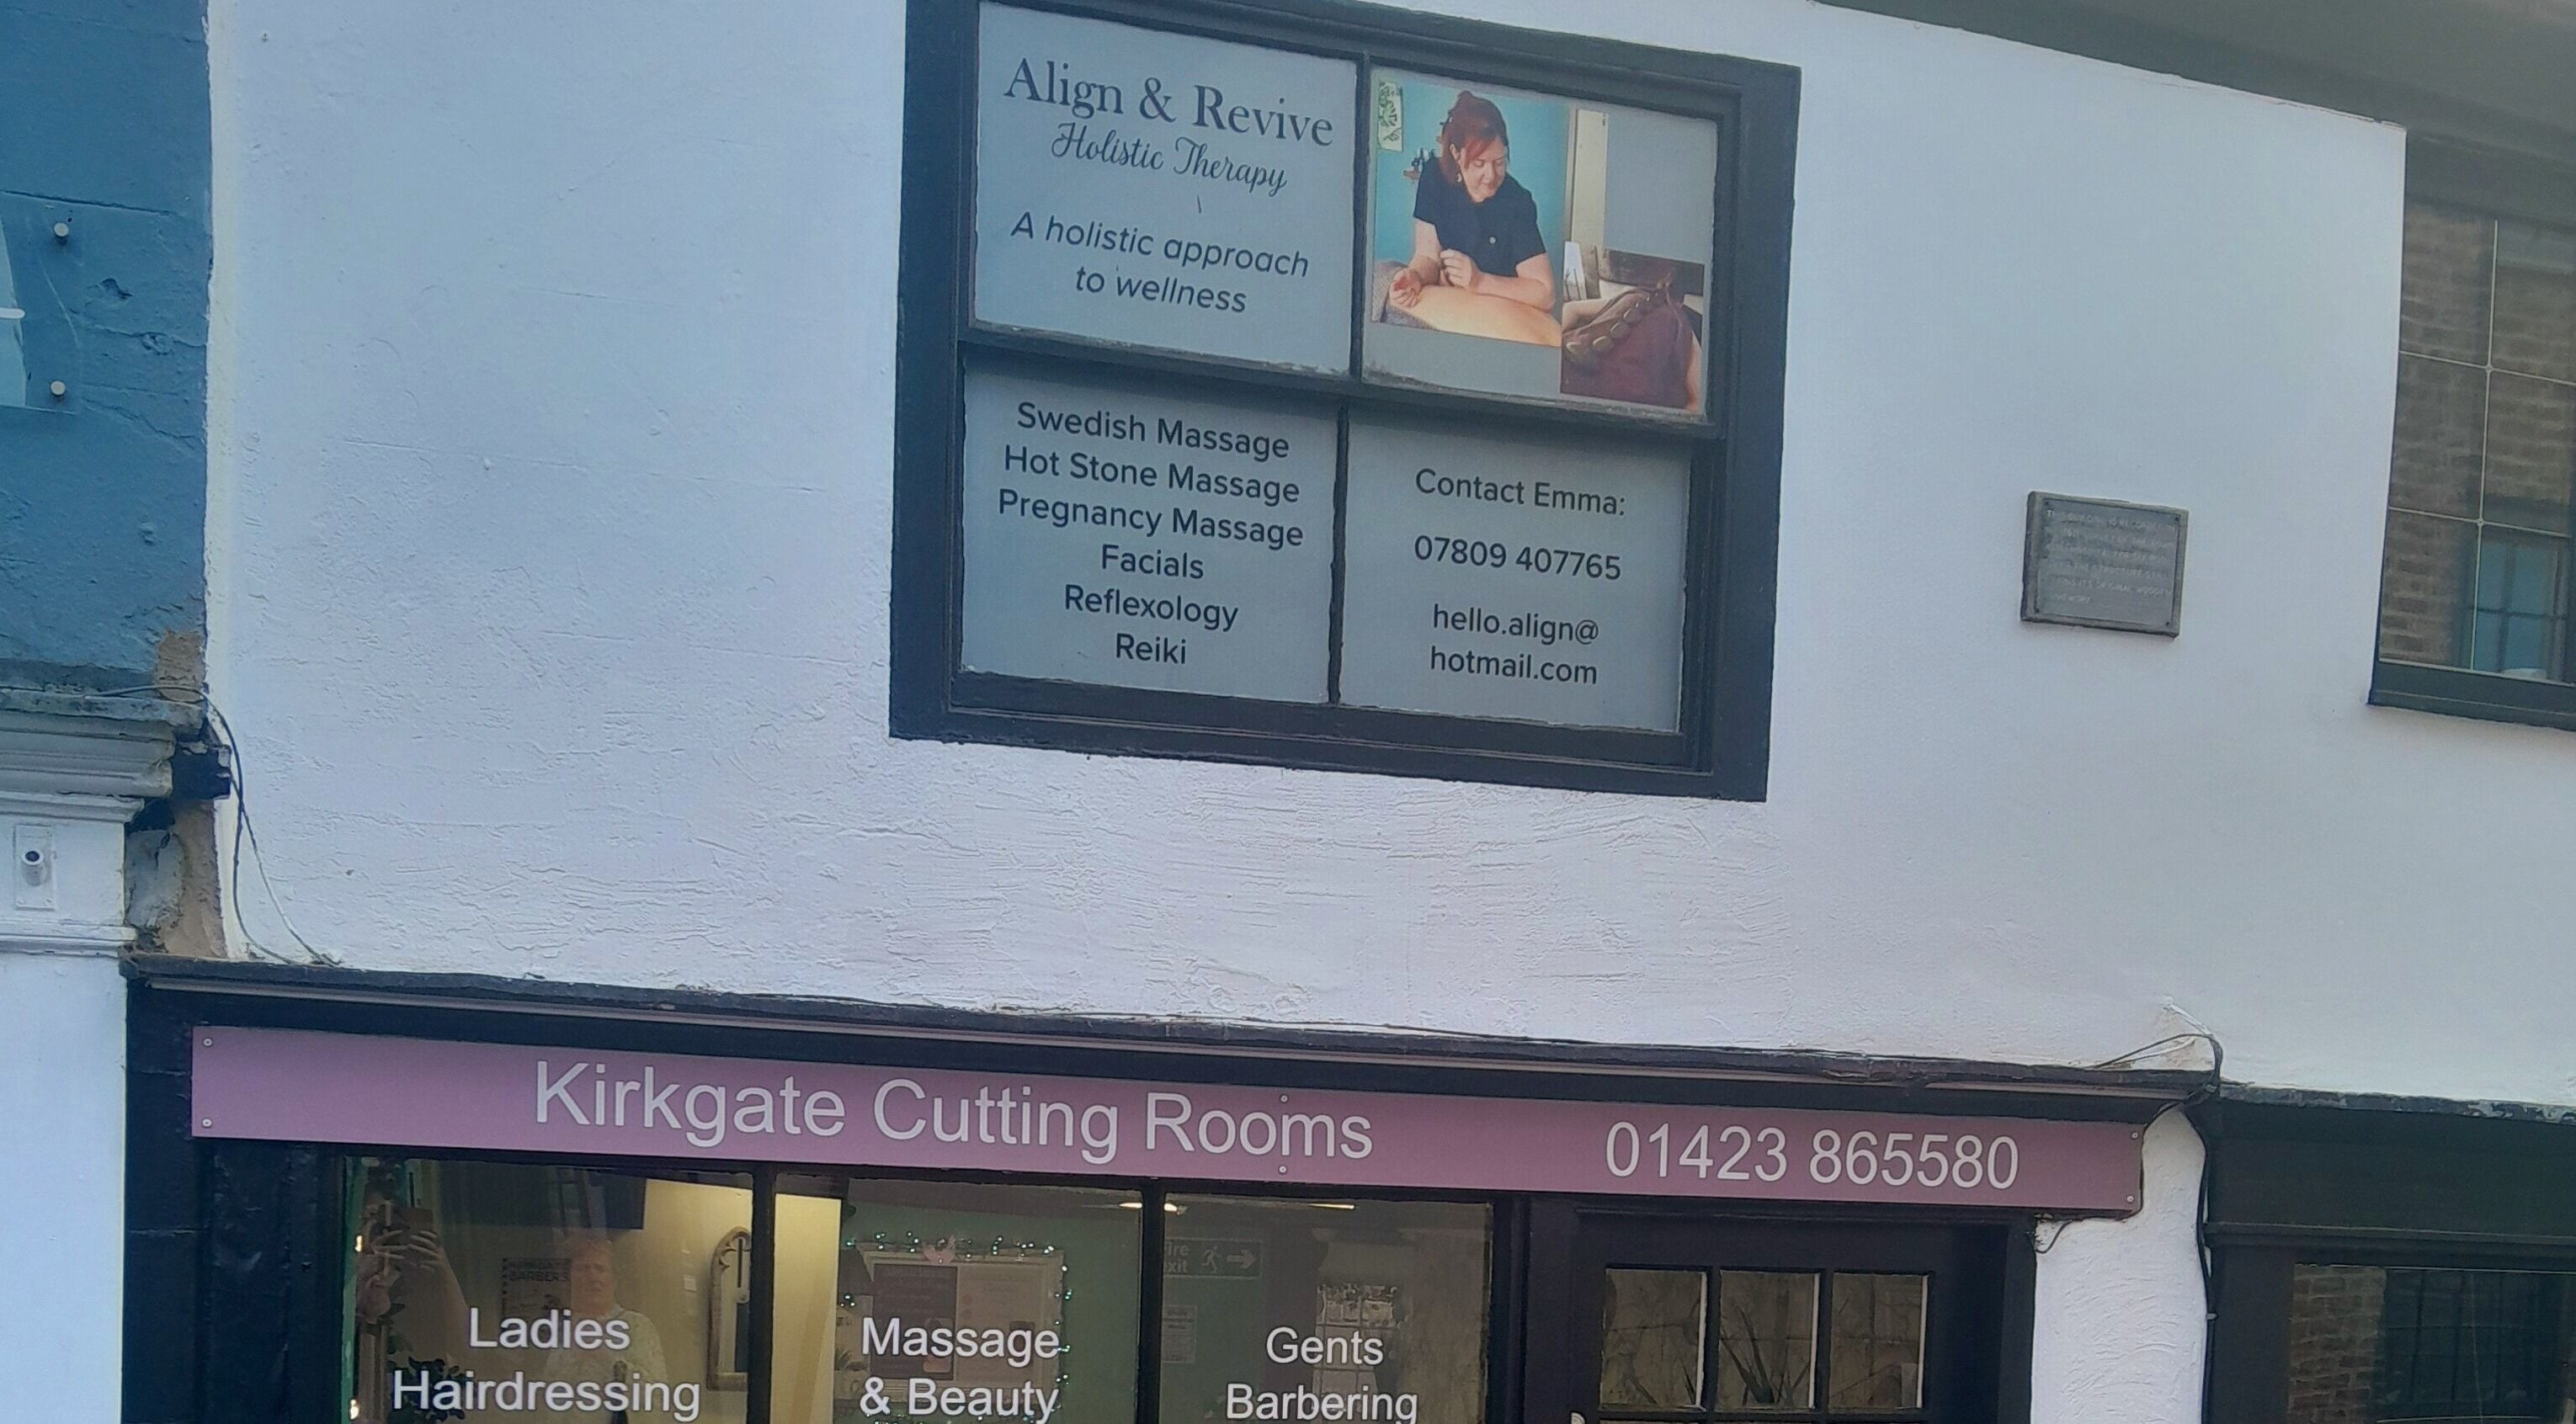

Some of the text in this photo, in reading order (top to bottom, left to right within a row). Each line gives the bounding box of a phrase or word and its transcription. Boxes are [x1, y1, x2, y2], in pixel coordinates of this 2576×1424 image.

[1003, 57, 1333, 146] Align & Revive
[1051, 122, 1288, 197] Holistic Therapy
[1010, 211, 1309, 278] A holistic approach
[1076, 266, 1248, 313] to wellness
[1017, 401, 1291, 463] Swedish Massage
[1004, 444, 1300, 507] Hot Stone Massage
[1415, 468, 1626, 516] Contact Emma:
[998, 488, 1304, 550] Pregnancy Massage
[1101, 544, 1205, 580] Facials
[1413, 534, 1622, 581] 07809 407765
[1064, 583, 1238, 633] Reflexology
[1432, 603, 1599, 646] hello.align@
[1115, 633, 1187, 665] Reiki
[1429, 646, 1599, 685] hotmail.com
[535, 1060, 1374, 1165] Kirkgate Cutting Rooms
[1605, 1120, 2020, 1189] 01423 865580
[1164, 1258, 1188, 1274] xit
[468, 1307, 631, 1350] Ladies
[860, 1316, 1060, 1368] Massage
[1265, 1326, 1385, 1366] Gents
[392, 1369, 701, 1422] Hairdressing
[859, 1375, 1060, 1424] & Beauty
[1225, 1383, 1418, 1424] Barbering
